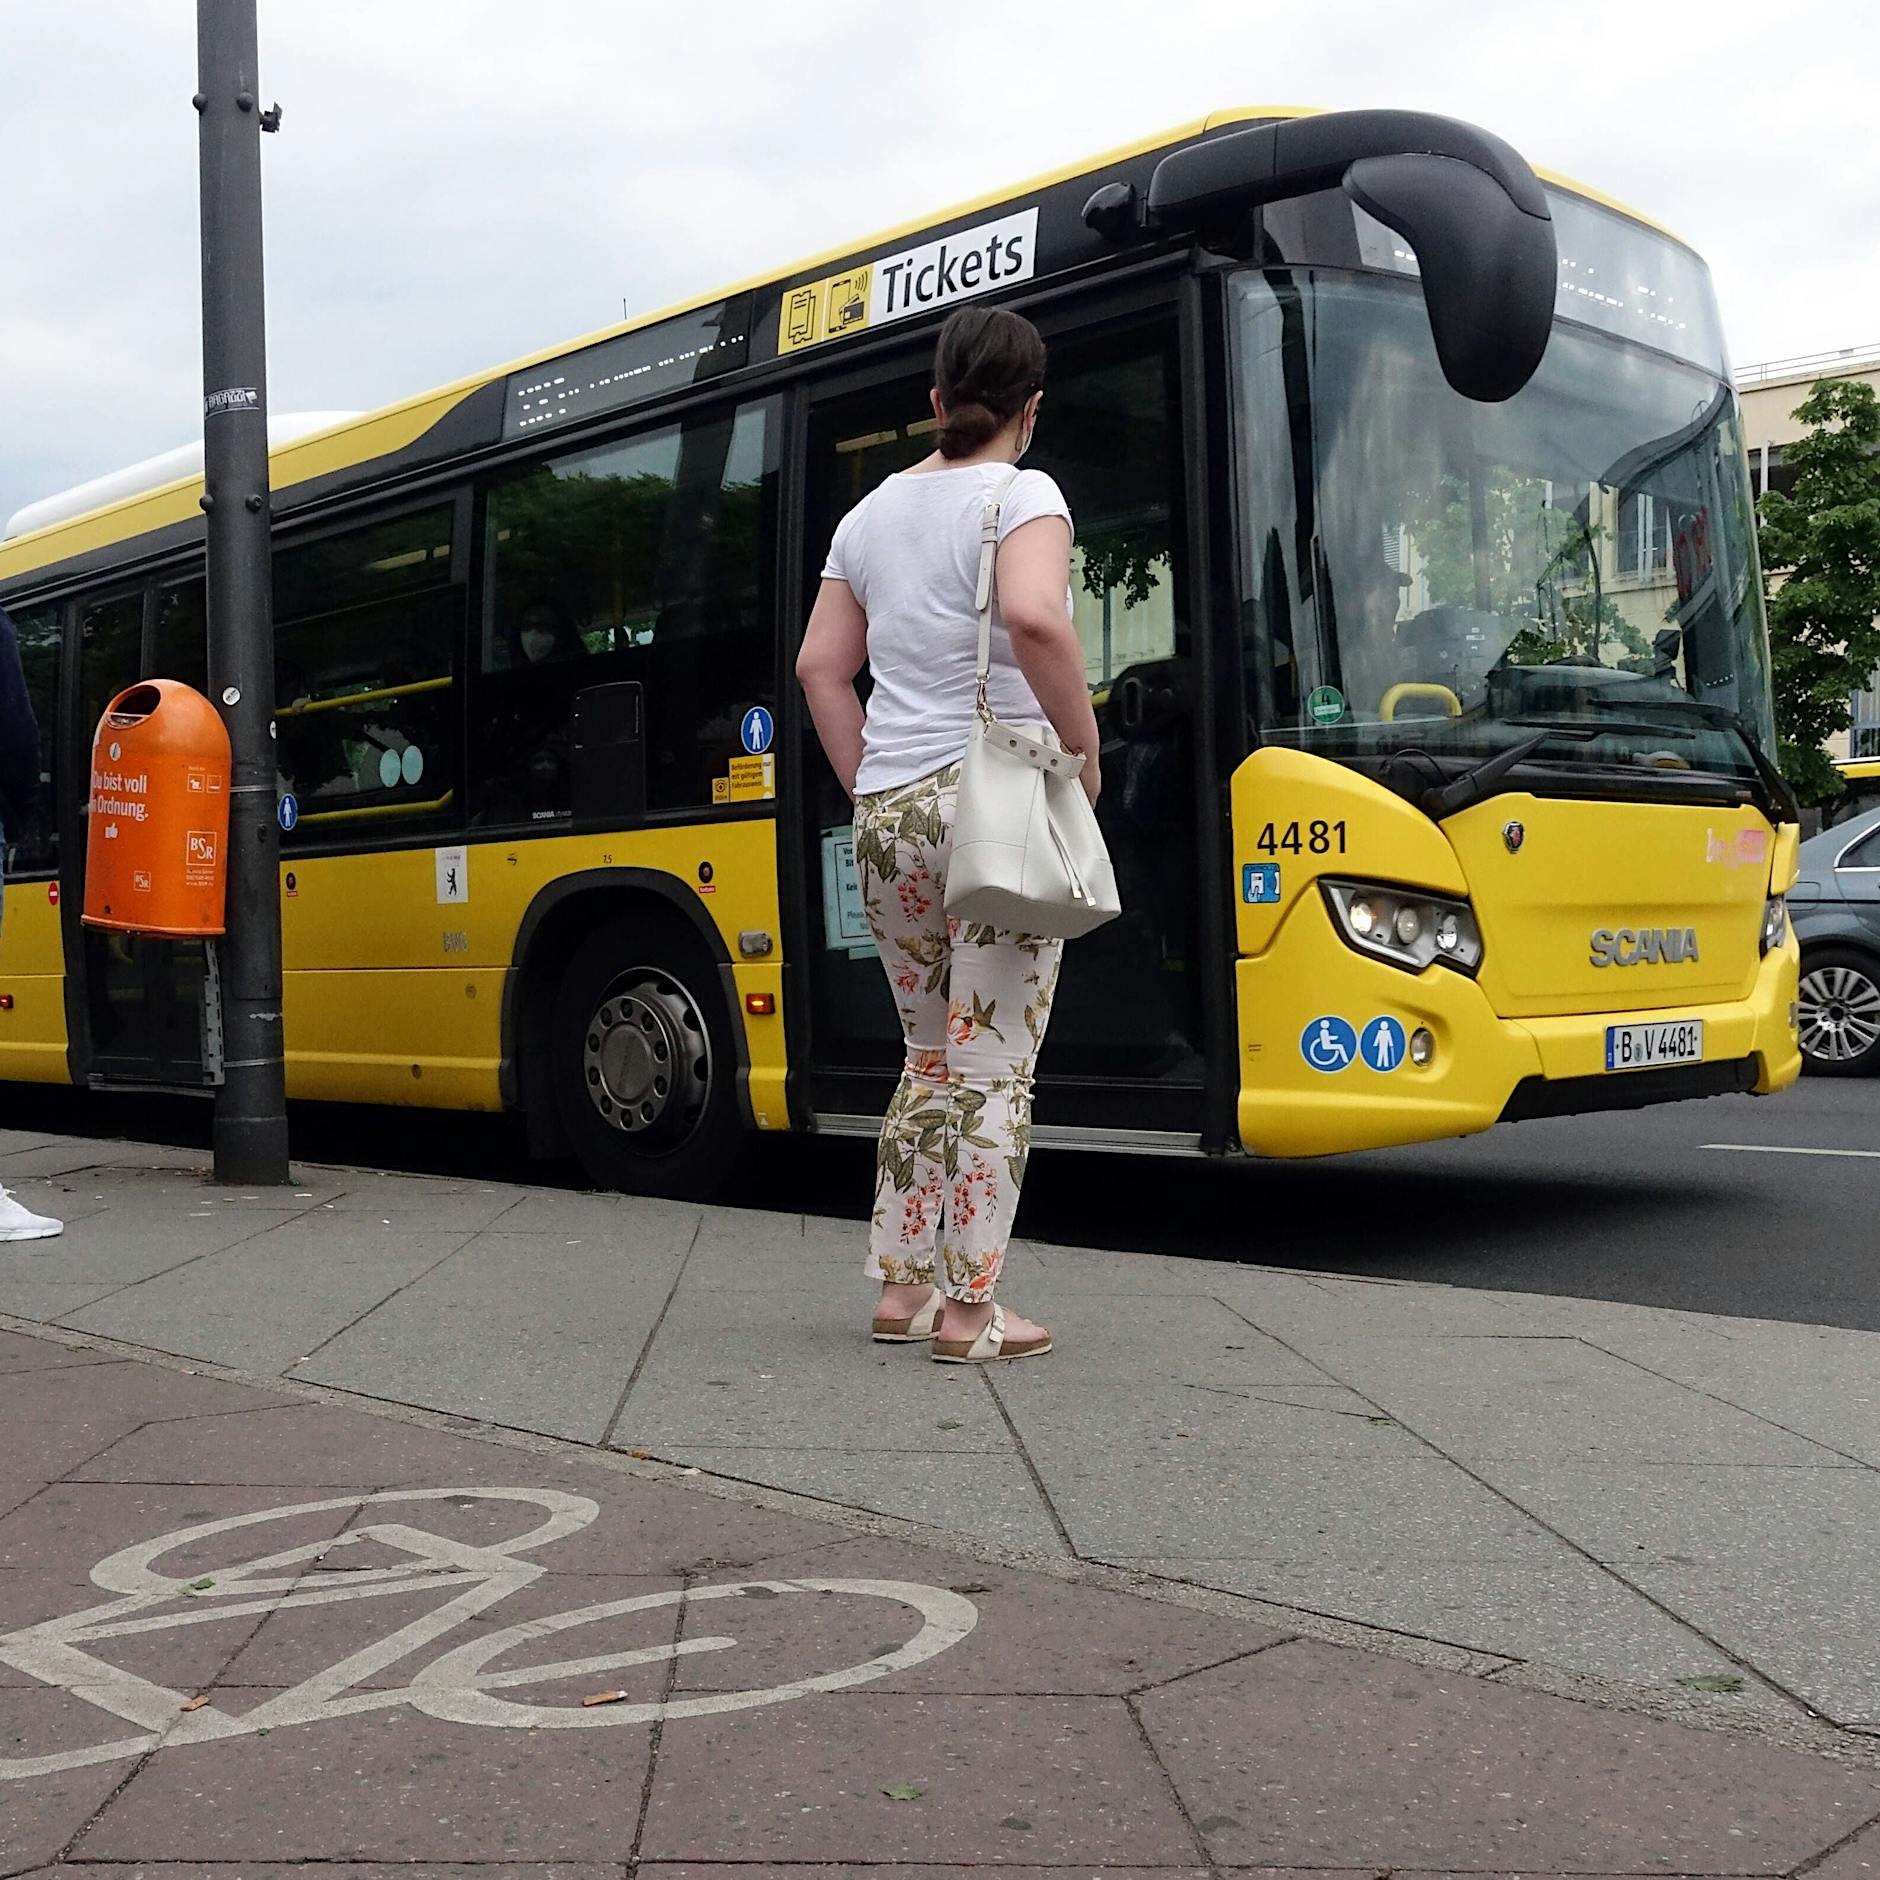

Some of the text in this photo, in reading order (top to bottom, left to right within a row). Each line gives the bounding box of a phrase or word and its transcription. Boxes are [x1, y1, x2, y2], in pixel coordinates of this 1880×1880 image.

[883, 234, 1023, 313] Tickets
[103, 771, 123, 791] bist
[123, 774, 148, 794] voll
[97, 795, 149, 822] Ordnung.
[190, 837, 214, 860] BSR
[1257, 820, 1345, 856] 4481
[1589, 927, 1699, 968] SCANIA
[1622, 1031, 1632, 1063] B
[1658, 1026, 1695, 1058] 4481
